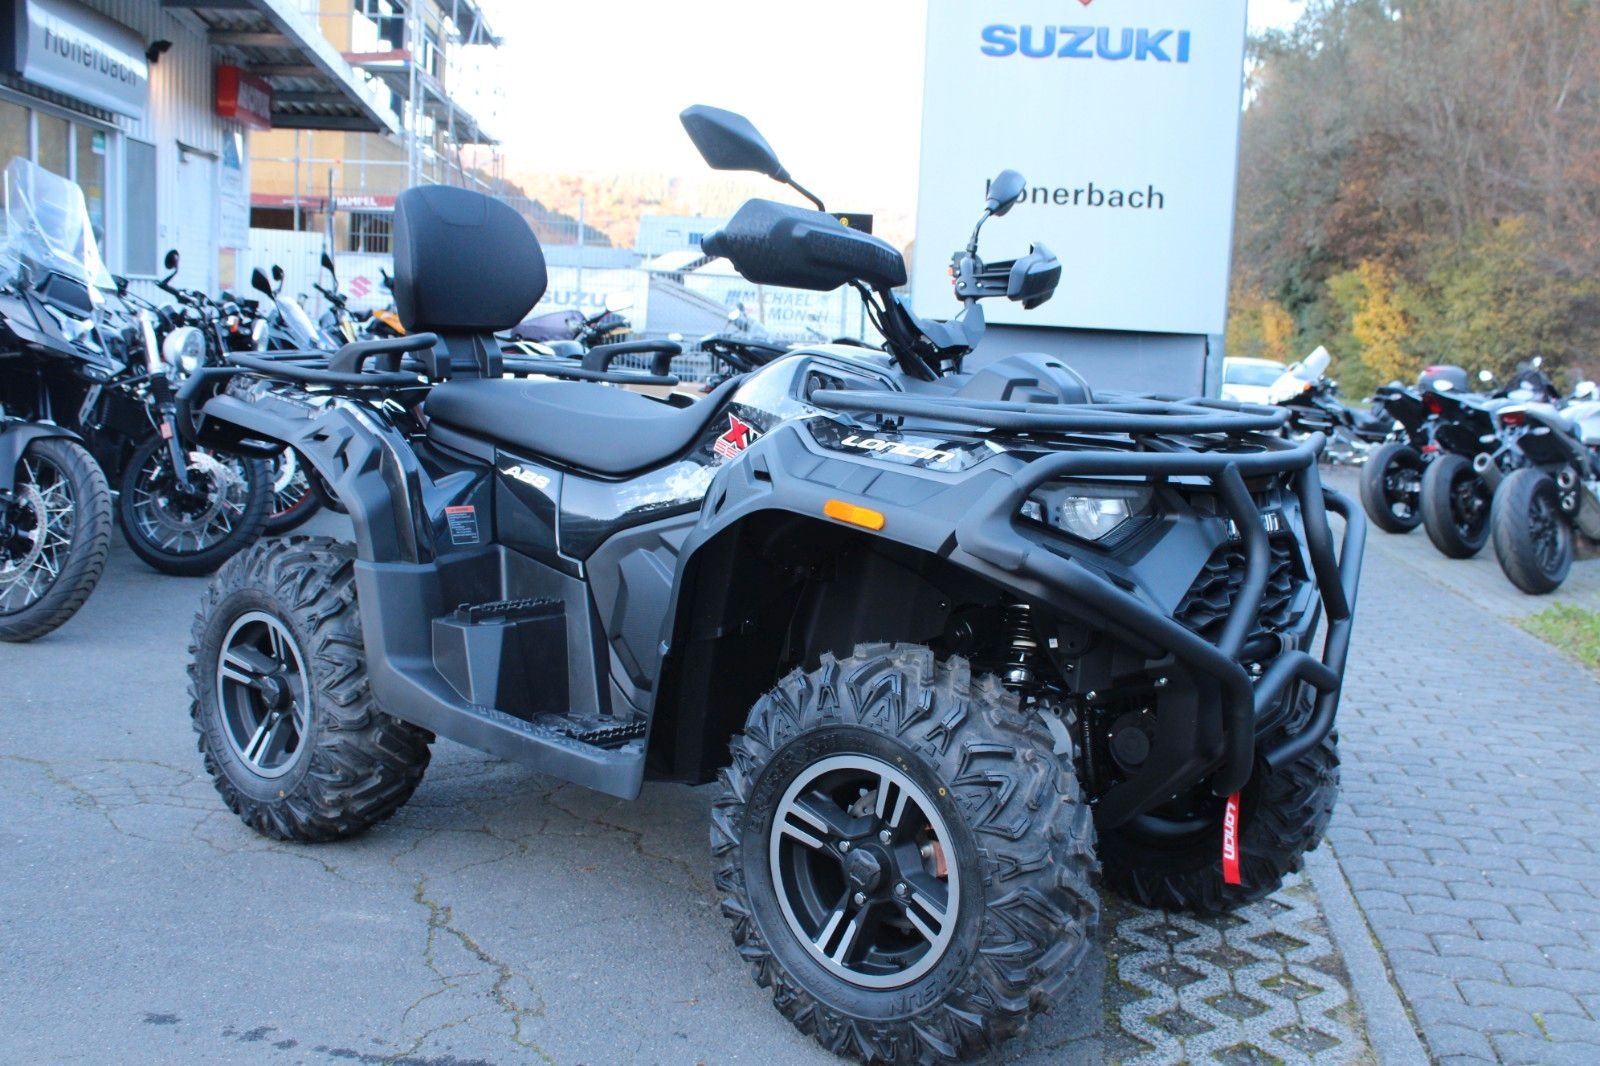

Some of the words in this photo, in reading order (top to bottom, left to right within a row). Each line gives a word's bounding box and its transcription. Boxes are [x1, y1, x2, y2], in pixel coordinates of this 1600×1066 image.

[980, 24, 1191, 63] SUZUKI
[540, 290, 607, 307] SUZU
[502, 465, 551, 489] ABS
